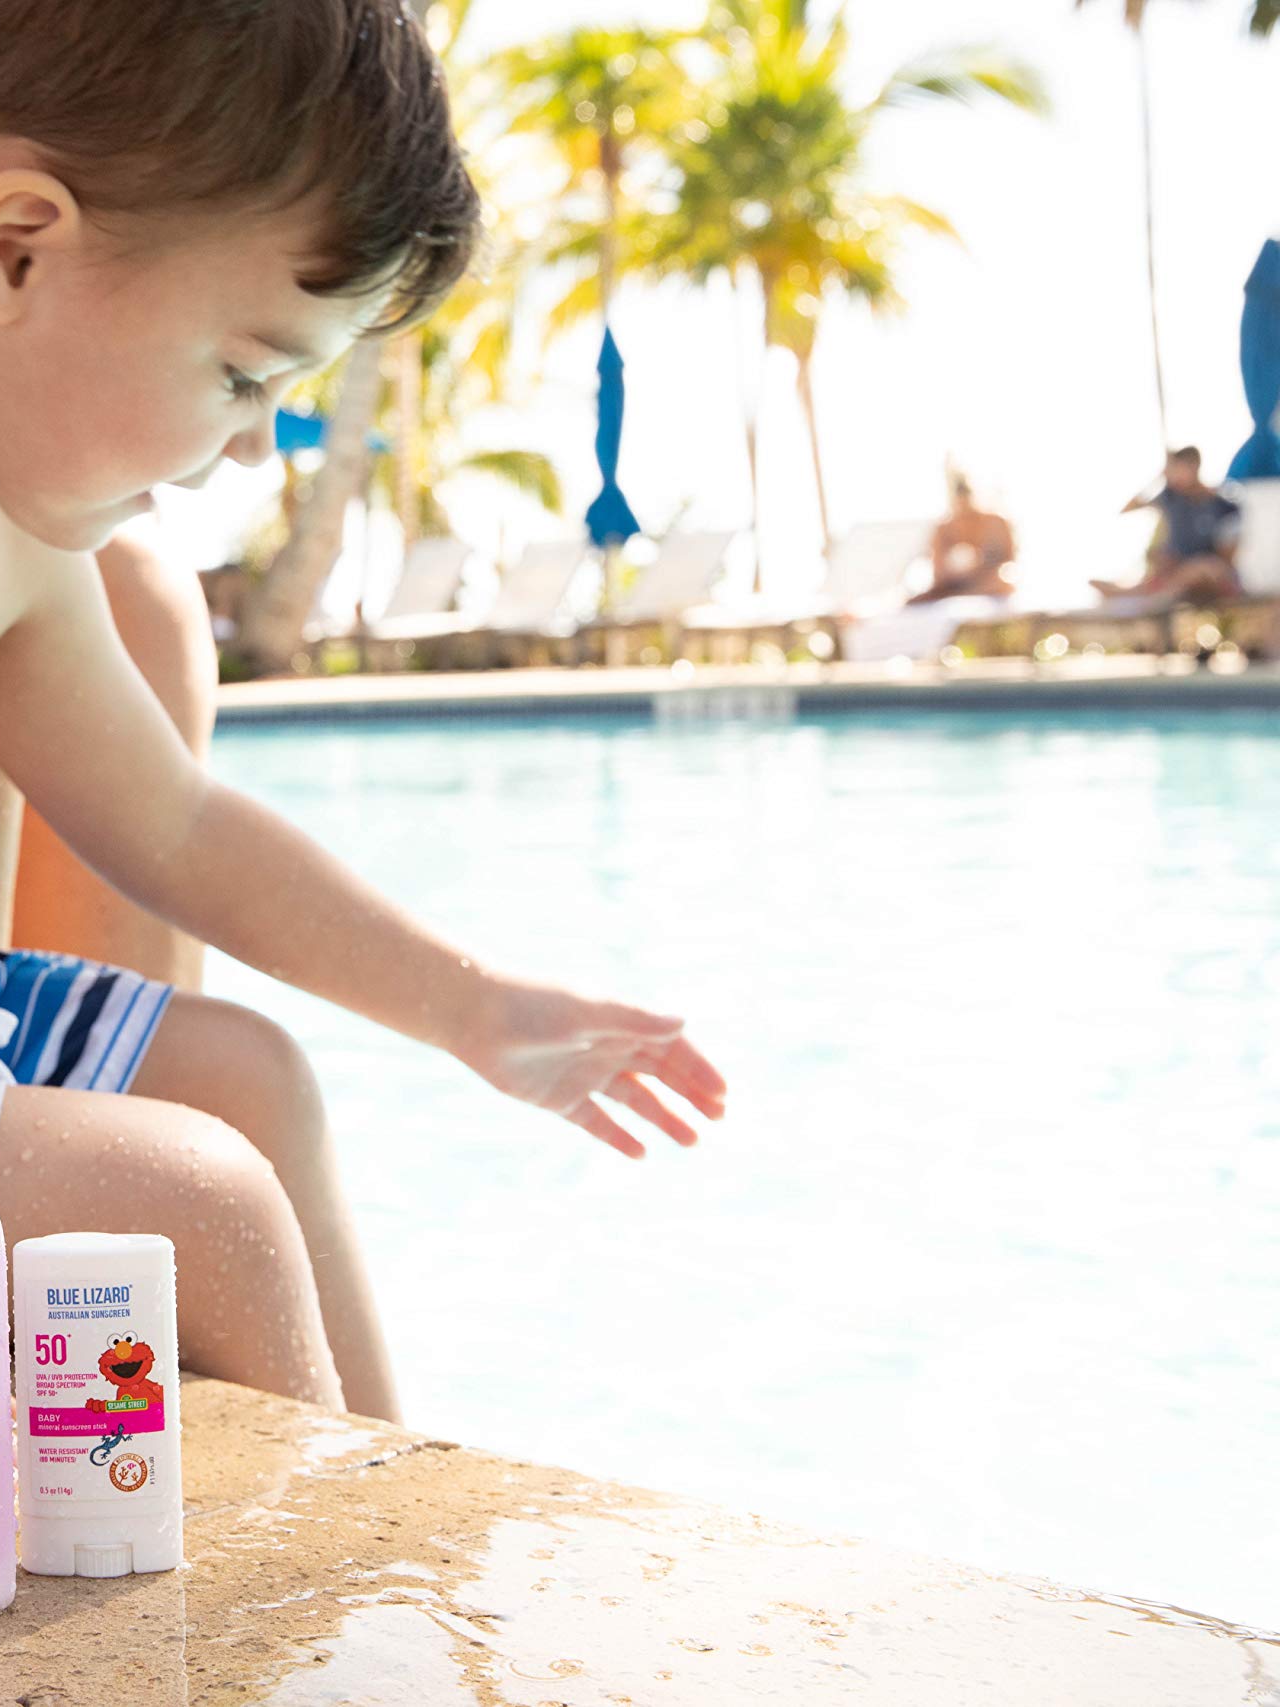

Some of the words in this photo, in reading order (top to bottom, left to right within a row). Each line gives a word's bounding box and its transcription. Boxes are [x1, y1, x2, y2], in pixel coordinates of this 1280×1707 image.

[47, 1289, 79, 1305] BLUE
[48, 1311, 89, 1320] AUSTRALIAN
[91, 1309, 130, 1318] SUNSCREEN
[107, 1402, 126, 1410] SESAME
[128, 1400, 146, 1409] STREET
[38, 1414, 60, 1422] BABY
[40, 1486, 48, 1494] 0.5
[58, 1487, 73, 1495] (14g)
